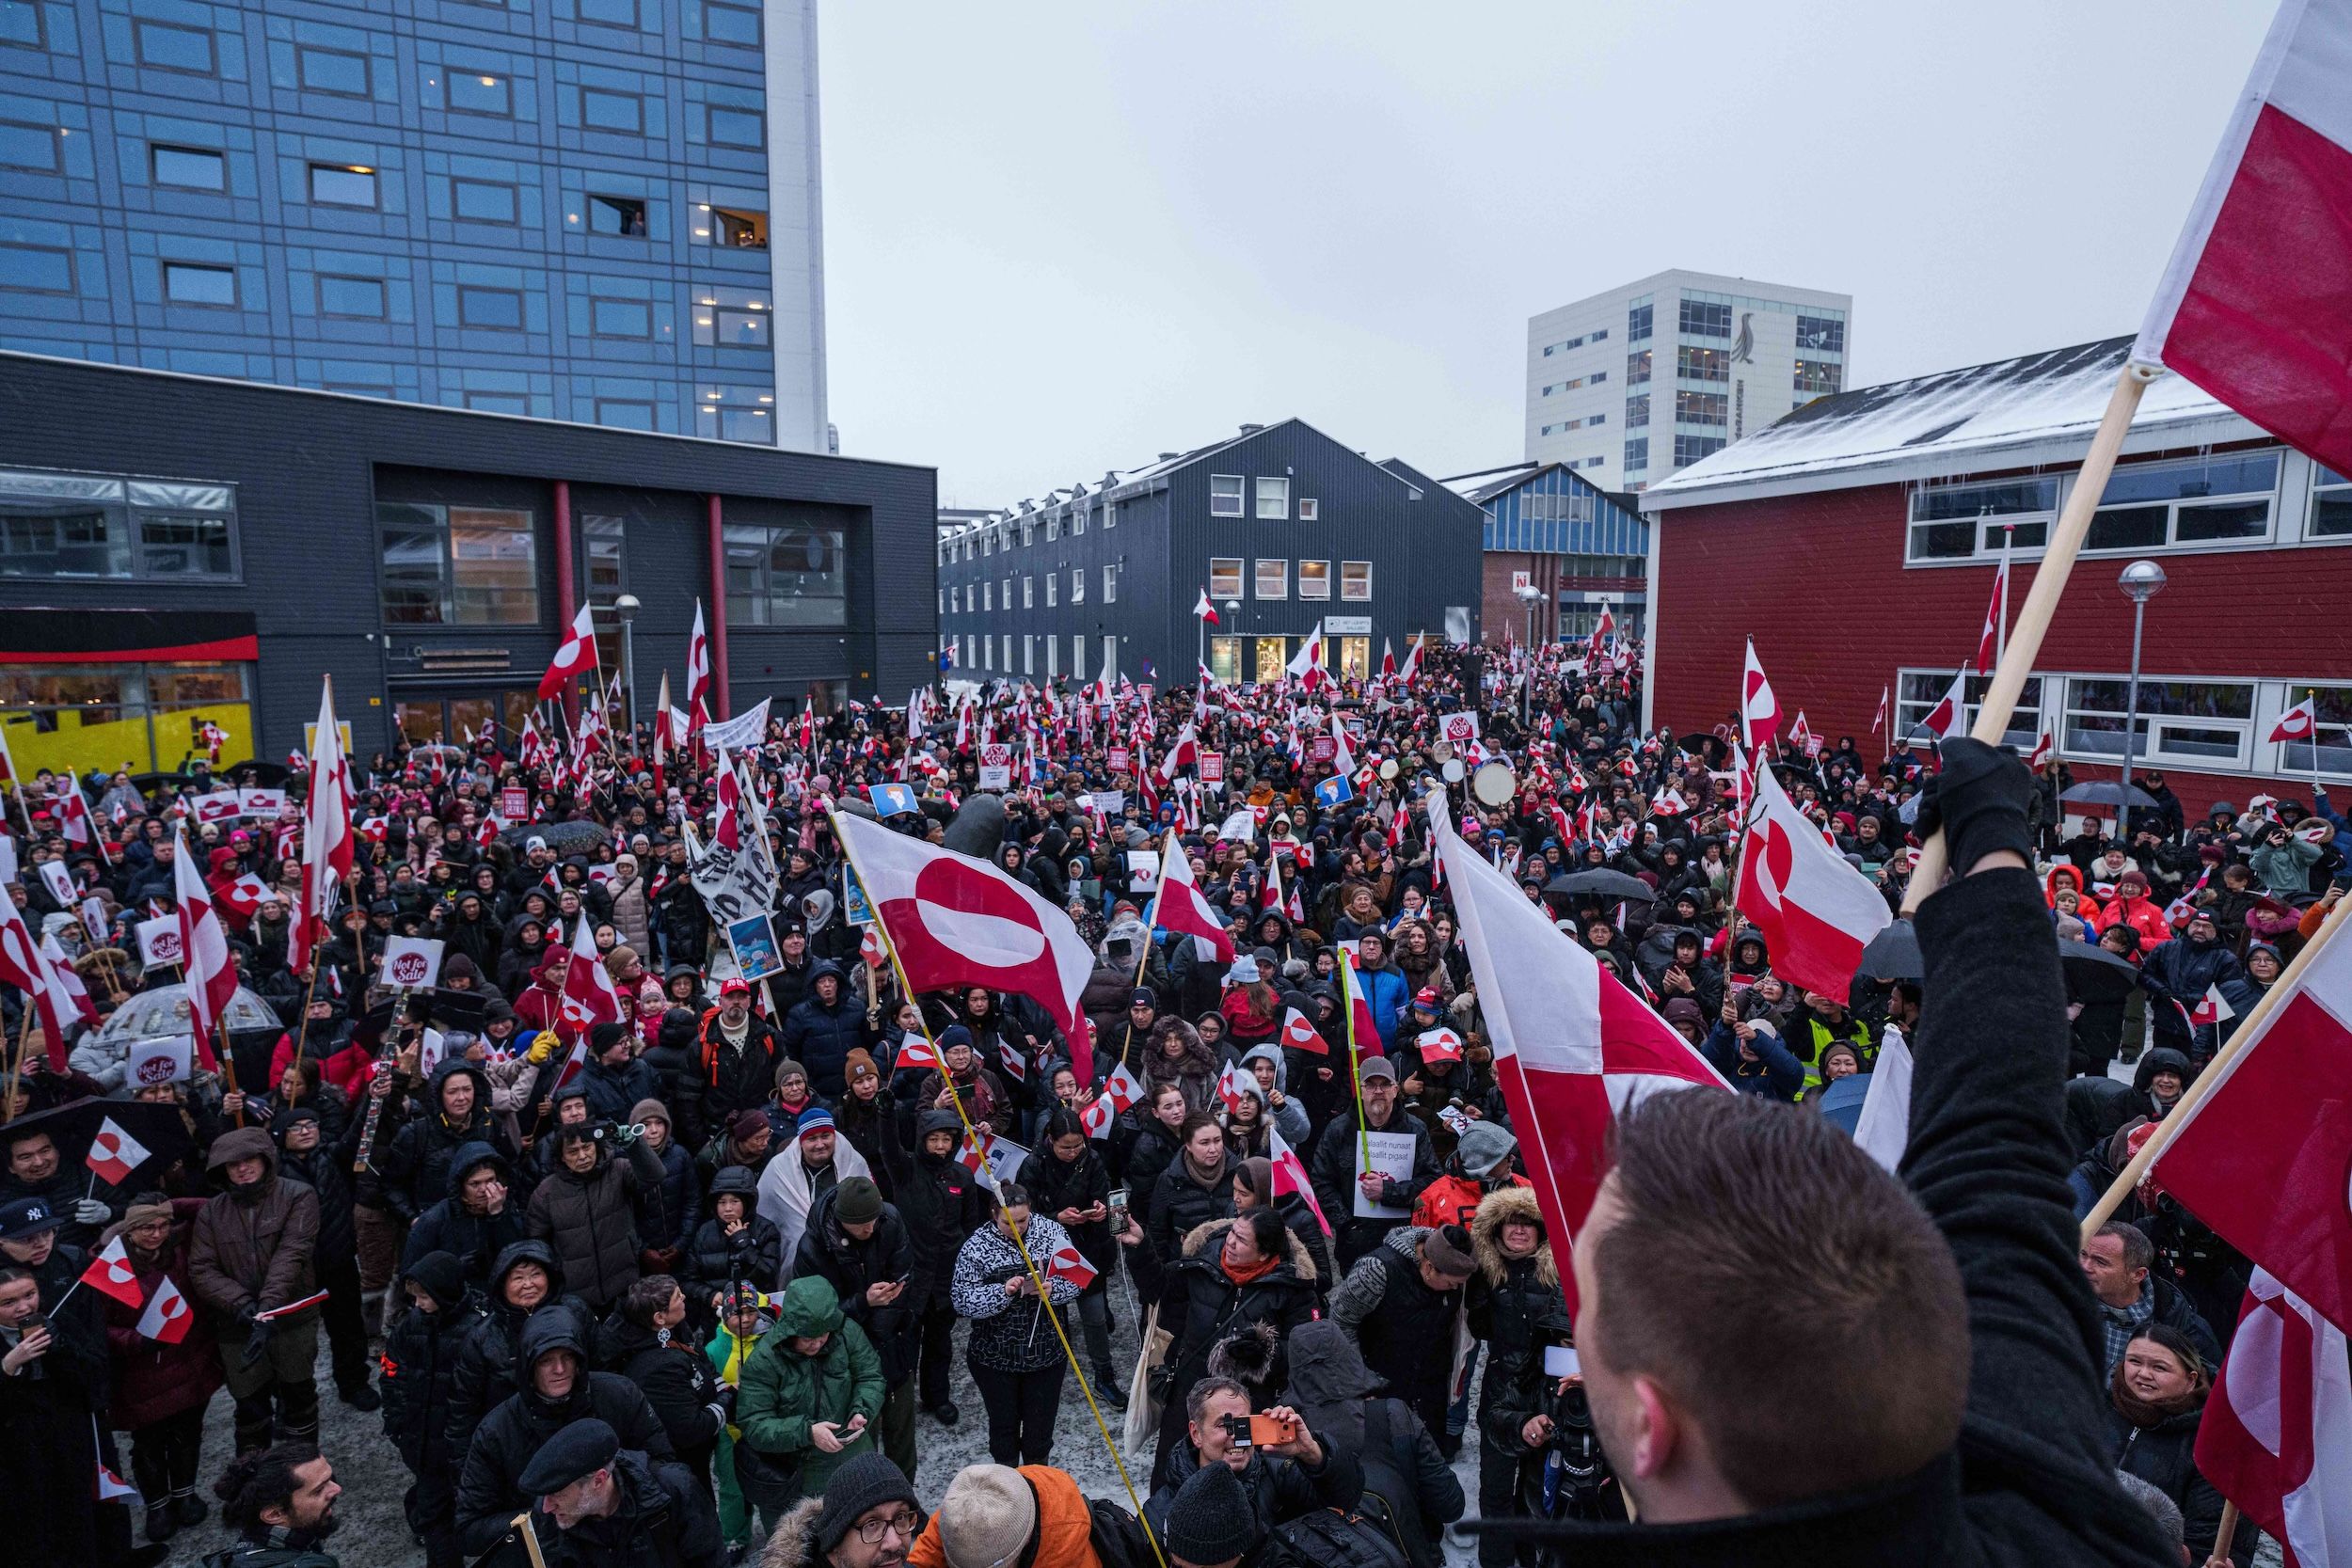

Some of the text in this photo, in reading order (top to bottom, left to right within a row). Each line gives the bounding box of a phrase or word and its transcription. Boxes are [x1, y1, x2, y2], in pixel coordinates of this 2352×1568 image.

[158, 944, 182, 959] Sale
[393, 958, 428, 972] Not for
[397, 969, 424, 982] Sale
[138, 1060, 175, 1076] Not for
[144, 1069, 173, 1084] Sale
[1388, 1142, 1412, 1150] nunaat
[1388, 1152, 1409, 1162] pigaat
[27, 1208, 43, 1221] NY
